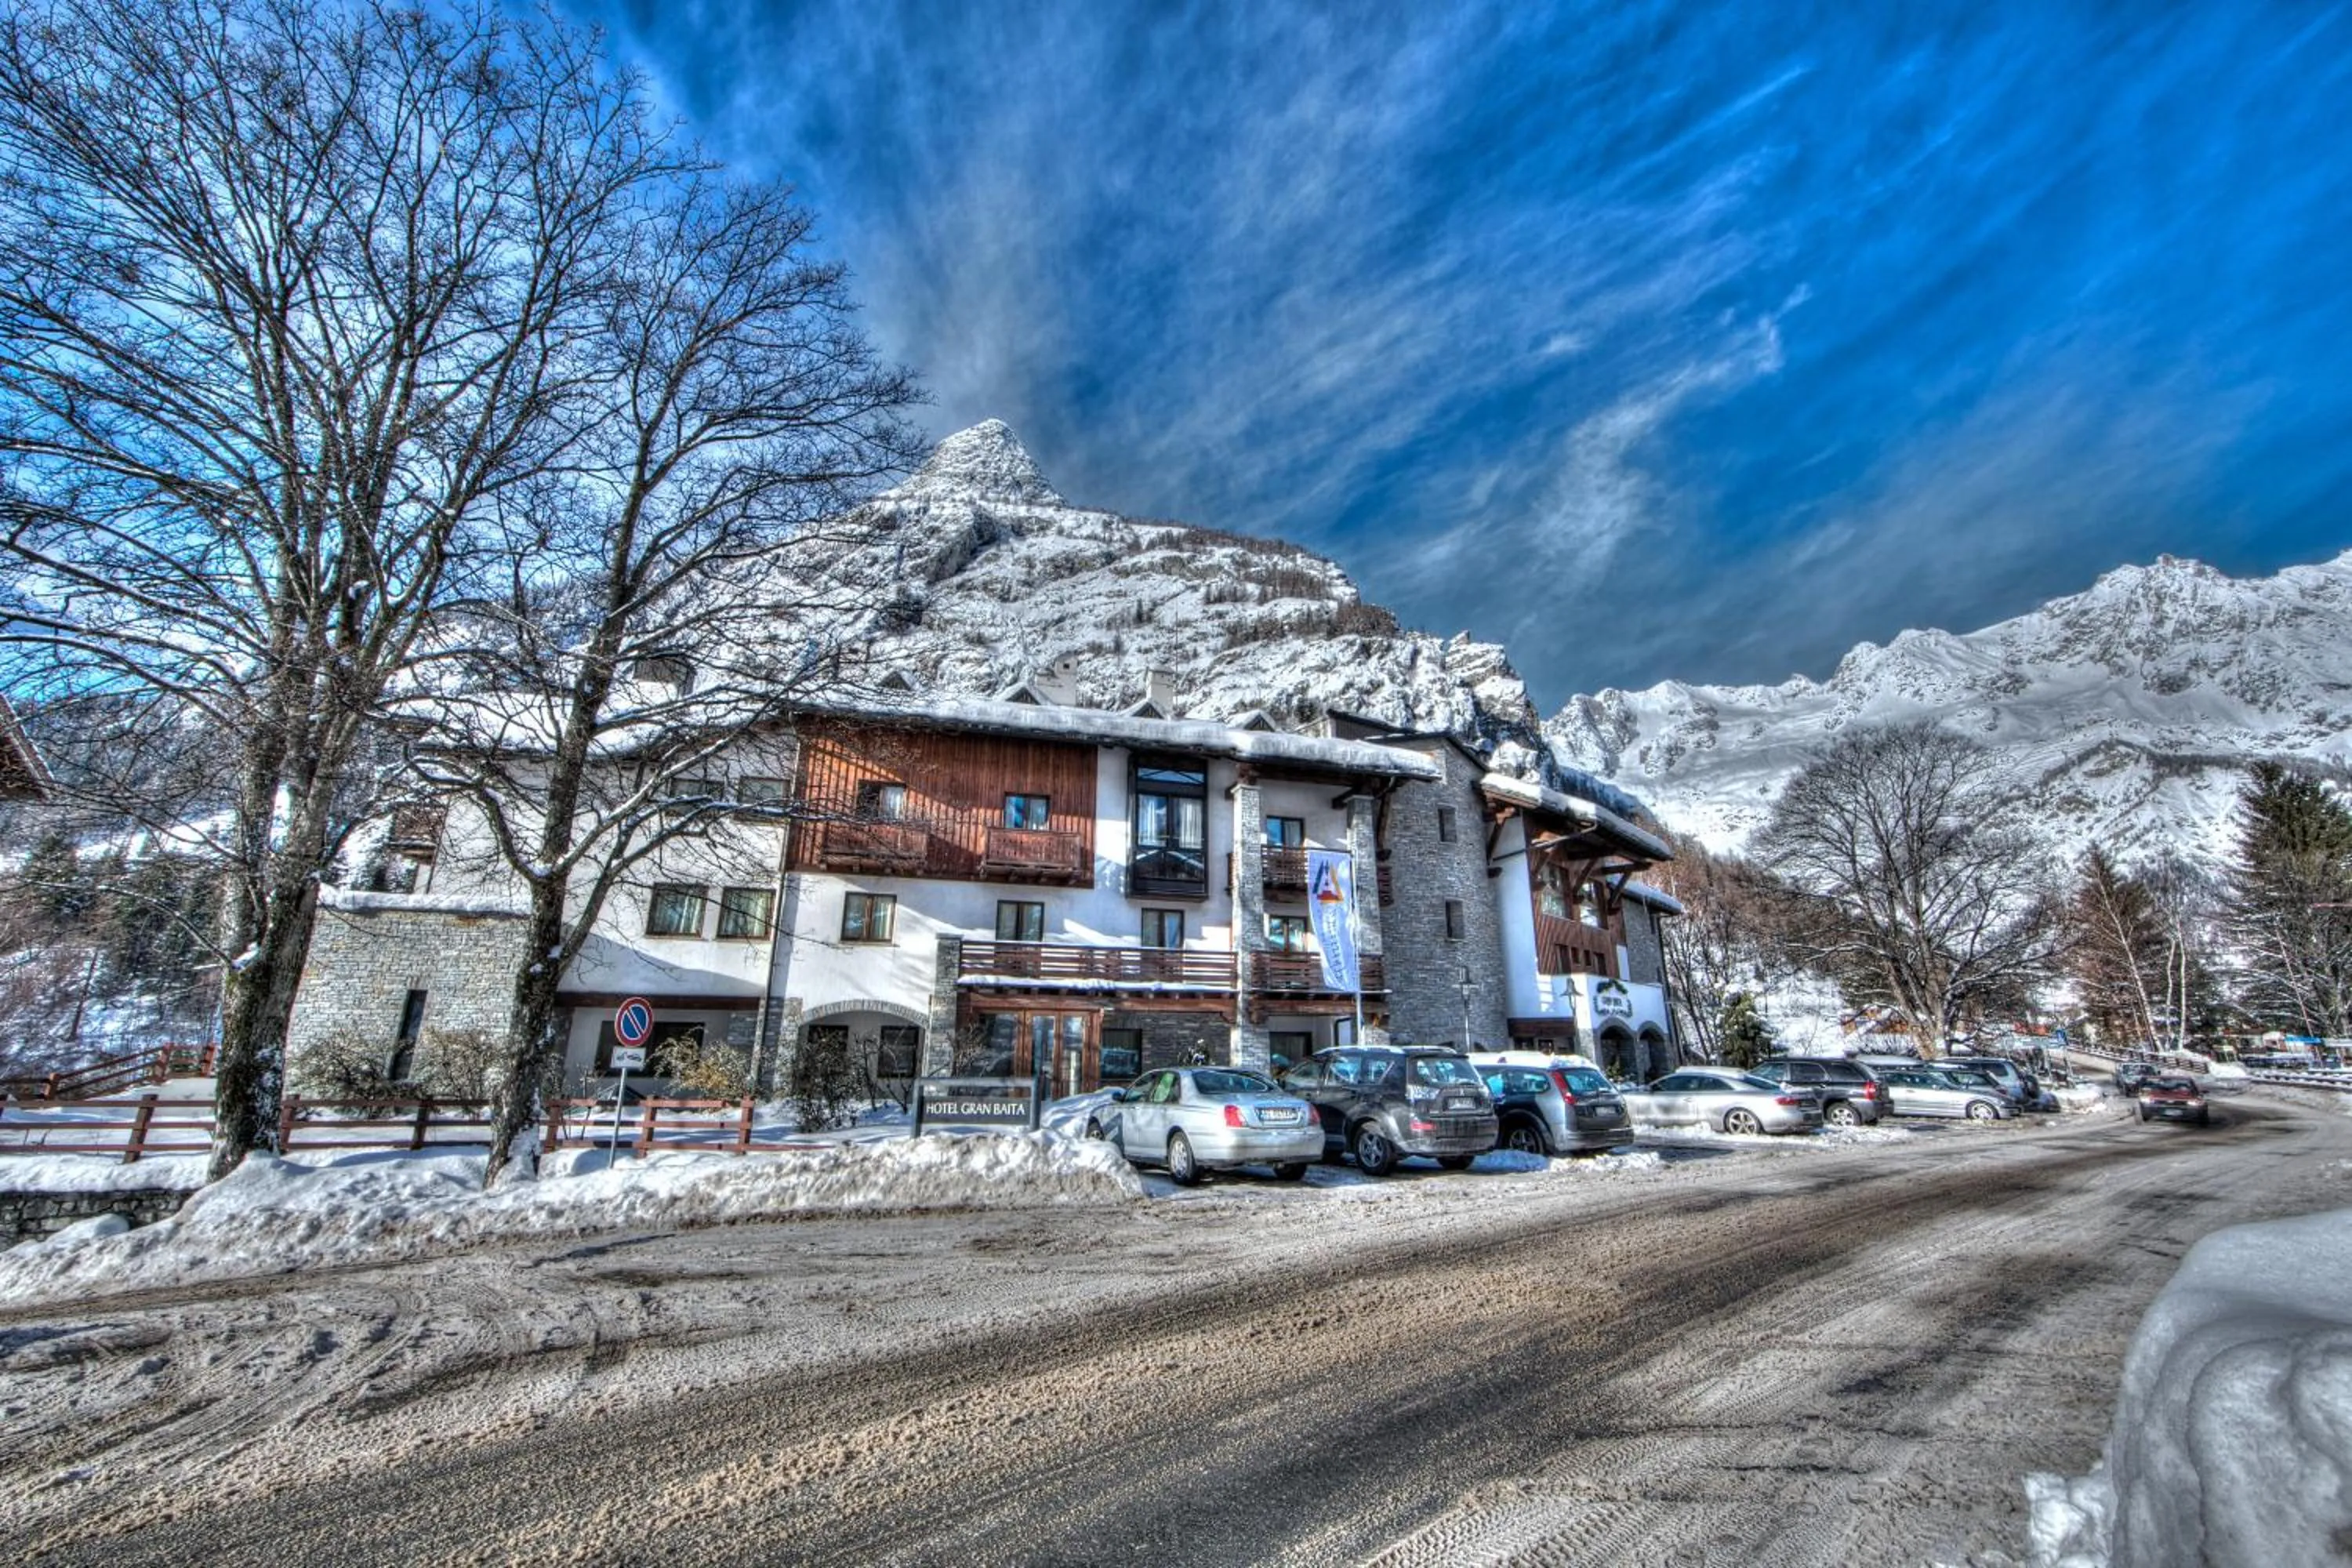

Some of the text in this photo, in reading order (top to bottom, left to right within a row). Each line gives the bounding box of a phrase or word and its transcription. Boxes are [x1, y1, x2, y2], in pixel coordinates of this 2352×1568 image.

[926, 1102, 1025, 1115] HOTEL GRAN BAITA
